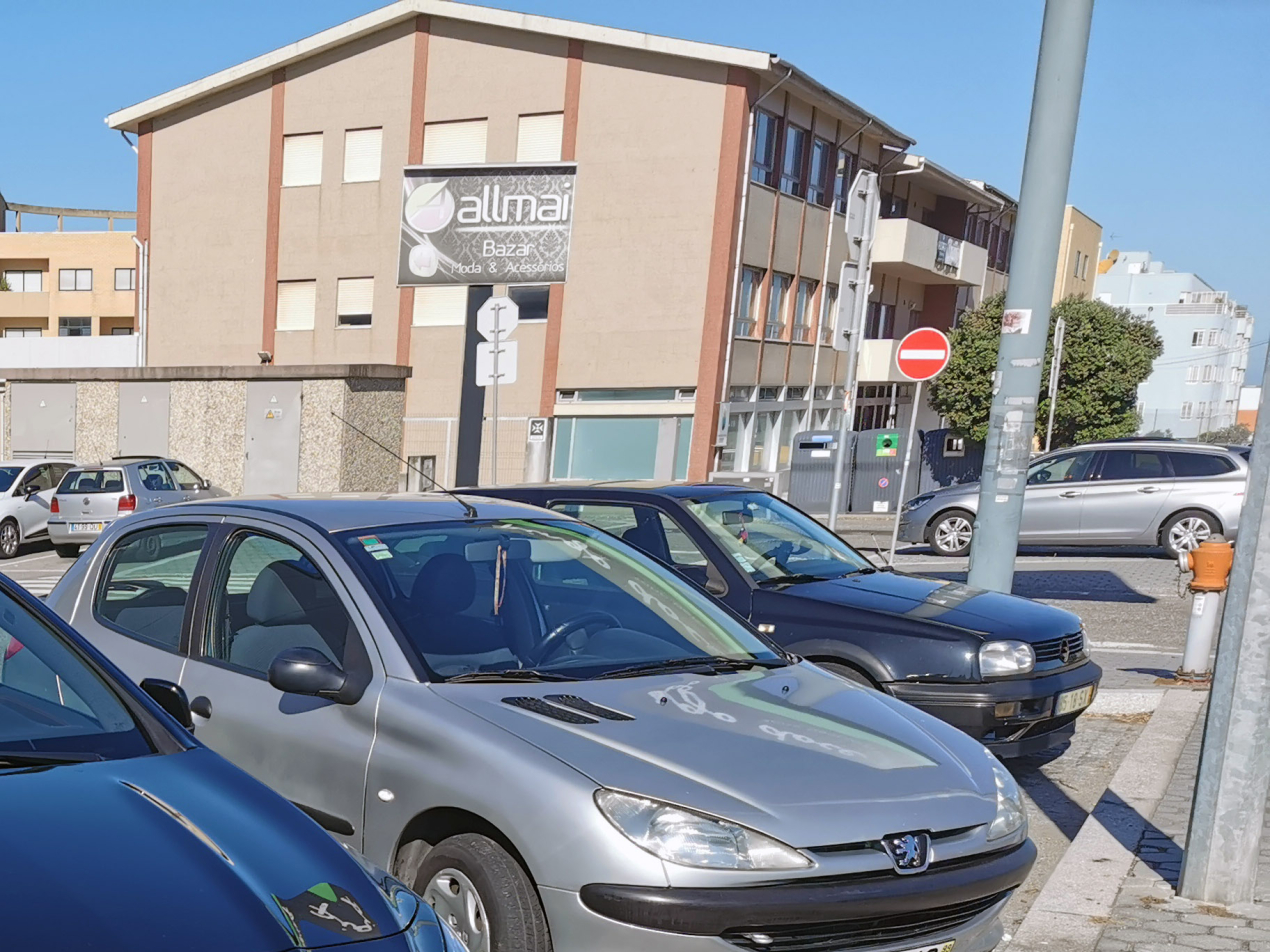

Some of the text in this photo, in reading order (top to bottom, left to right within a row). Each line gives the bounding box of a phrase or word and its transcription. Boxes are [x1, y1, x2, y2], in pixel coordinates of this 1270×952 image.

[456, 182, 571, 224] allmai
[483, 240, 535, 257] Bazar
[451, 262, 482, 274] Moda
[488, 261, 498, 273] &
